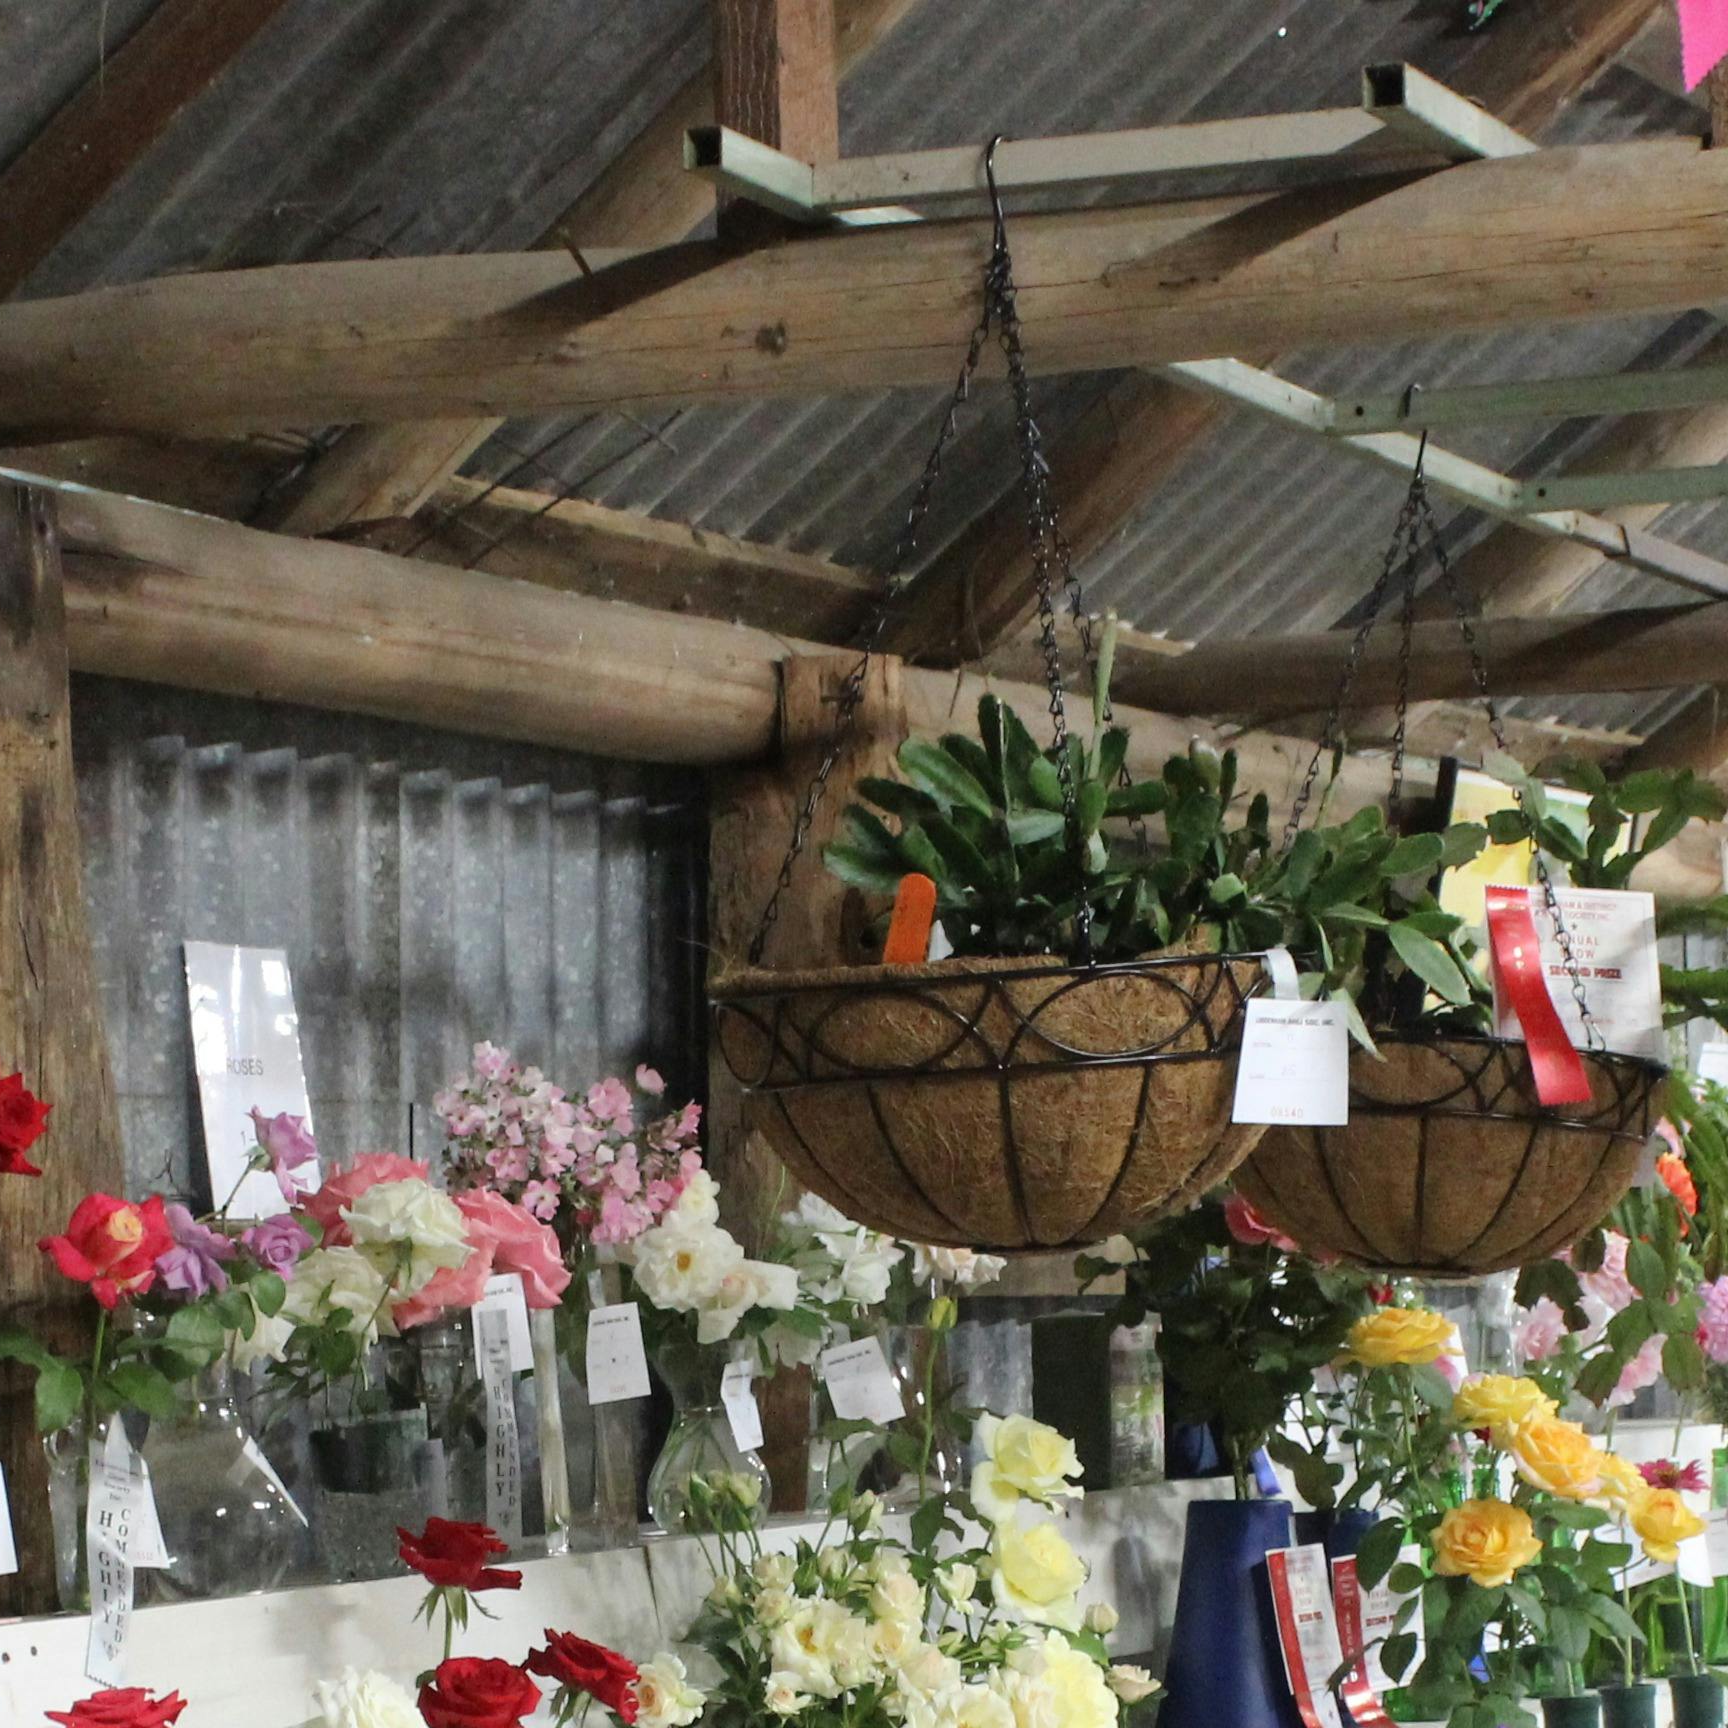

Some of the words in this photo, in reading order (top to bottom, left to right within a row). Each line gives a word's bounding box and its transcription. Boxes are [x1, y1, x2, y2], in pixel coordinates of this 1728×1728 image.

[1549, 965, 1592, 977] SECOND
[1593, 968, 1623, 980] PRIZE
[226, 1058, 264, 1076] ROSES
[493, 1385, 506, 1499] HIGHLY
